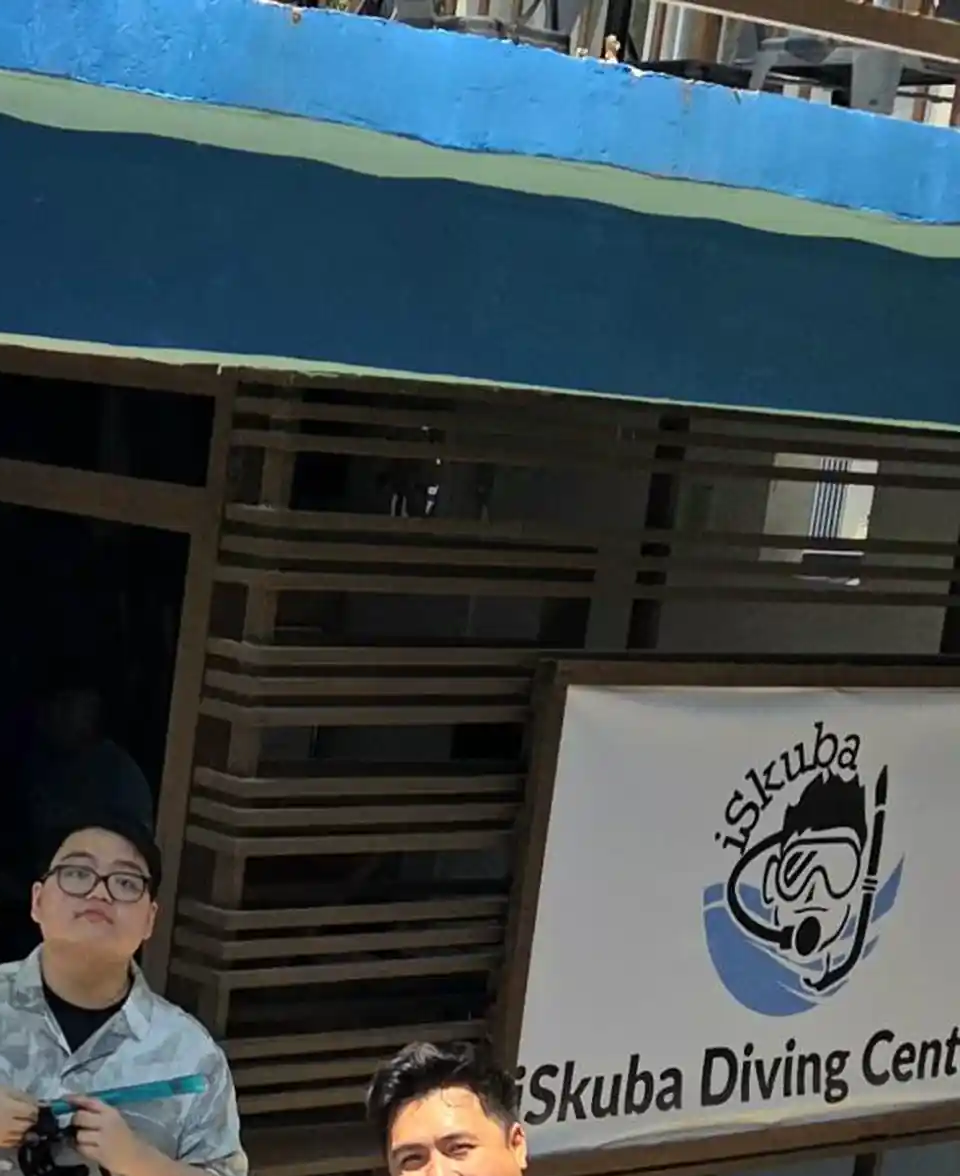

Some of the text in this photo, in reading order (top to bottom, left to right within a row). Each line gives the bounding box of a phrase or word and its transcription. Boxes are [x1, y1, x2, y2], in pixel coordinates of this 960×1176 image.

[715, 722, 861, 855] iSkuba
[515, 1054, 683, 1126] iSkuba
[700, 1038, 851, 1103] Diving
